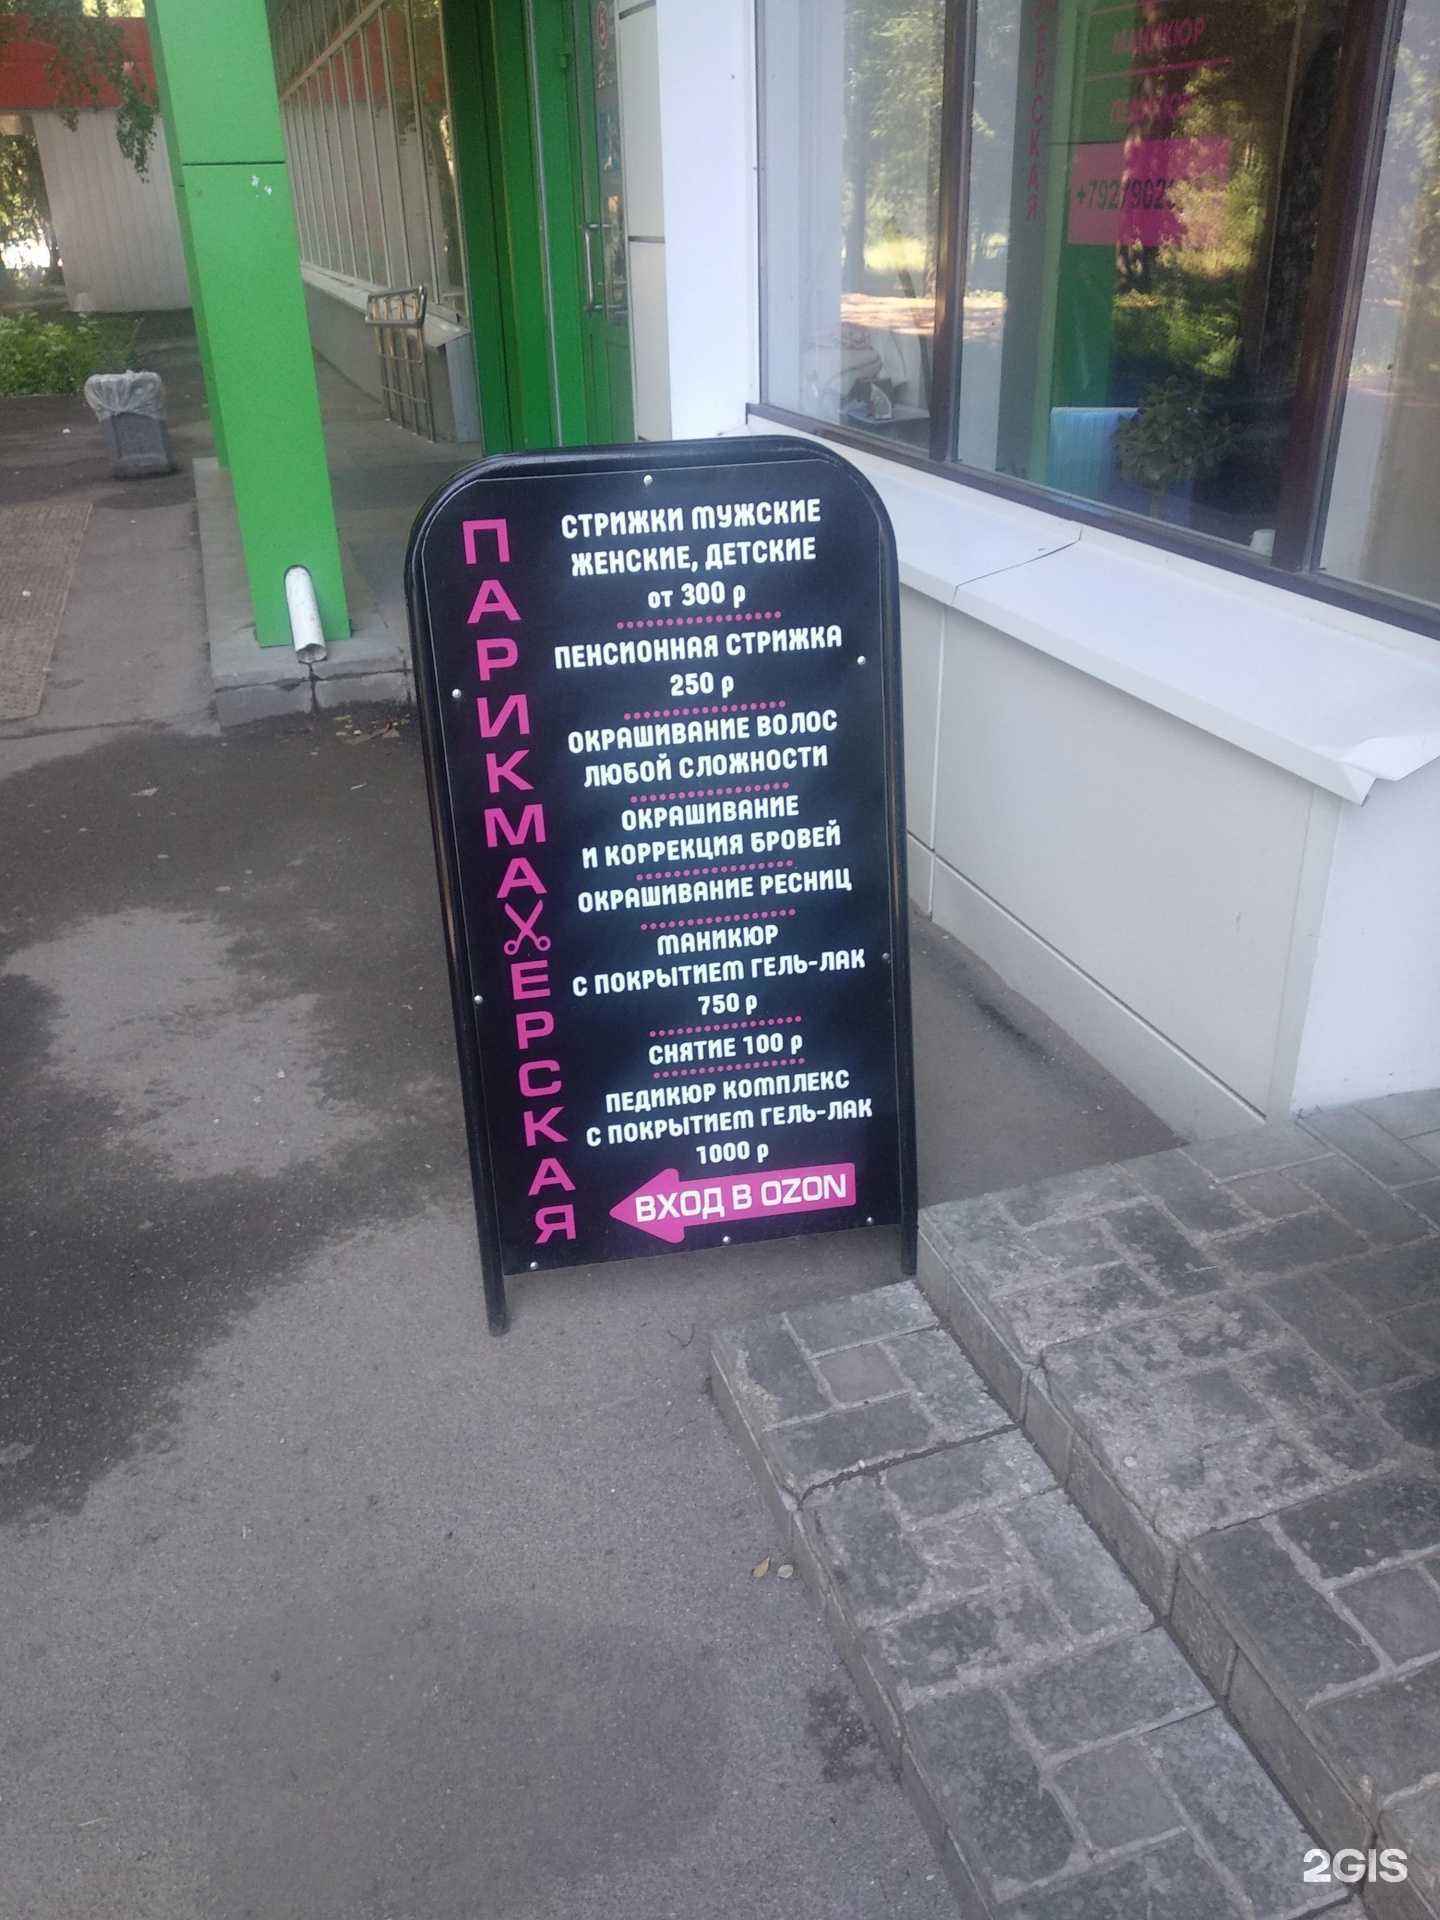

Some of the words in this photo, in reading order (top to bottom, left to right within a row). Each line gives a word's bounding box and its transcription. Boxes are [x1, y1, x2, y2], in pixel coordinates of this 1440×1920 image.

[561, 507, 684, 539] СТРИЖКИ
[691, 498, 821, 530] МУЖСКИЕ
[571, 545, 698, 577] ЖЕНСКИЕ,
[704, 536, 817, 571] ДЕТСКИЕ
[680, 580, 726, 607] 300
[554, 634, 719, 670] ПЕНСИОННАЯ
[725, 624, 842, 656] СТРИЖКА
[669, 671, 714, 697] 250
[567, 716, 751, 754] ОКРАШИВАНИЕ
[756, 709, 838, 737] ВОЛОС
[583, 752, 672, 788] ЛЮБОЙ
[678, 744, 828, 779] СЛОЖНОСТИ
[621, 794, 799, 831] ОКРАШИВАНИЕ
[604, 833, 744, 865] КОРРЕКЦИЯ
[750, 819, 841, 853] БРОВЕЙ
[578, 876, 754, 913] ОКРАШИВАНИЕ
[760, 867, 853, 896] РЕСНИЦ
[657, 924, 779, 956] МАНИКЮР
[594, 960, 745, 995] ПОКРЫТИЕМ
[750, 948, 866, 978] ГЕЛЬ-ЛАК
[697, 992, 740, 1016] 750
[648, 1037, 737, 1065] СНЯТИЕ
[742, 1032, 784, 1055] 100
[605, 1083, 717, 1113] ПЕДИКЮР
[722, 1069, 850, 1100] КОМПЛЕКС
[607, 1109, 755, 1146] ПОКРЫТИЕМ
[760, 1098, 873, 1127] ГЕЛЬ-ЛАК
[695, 1140, 751, 1165] 1000
[635, 1186, 726, 1223] ВХОД
[760, 1173, 847, 1207] OZON
